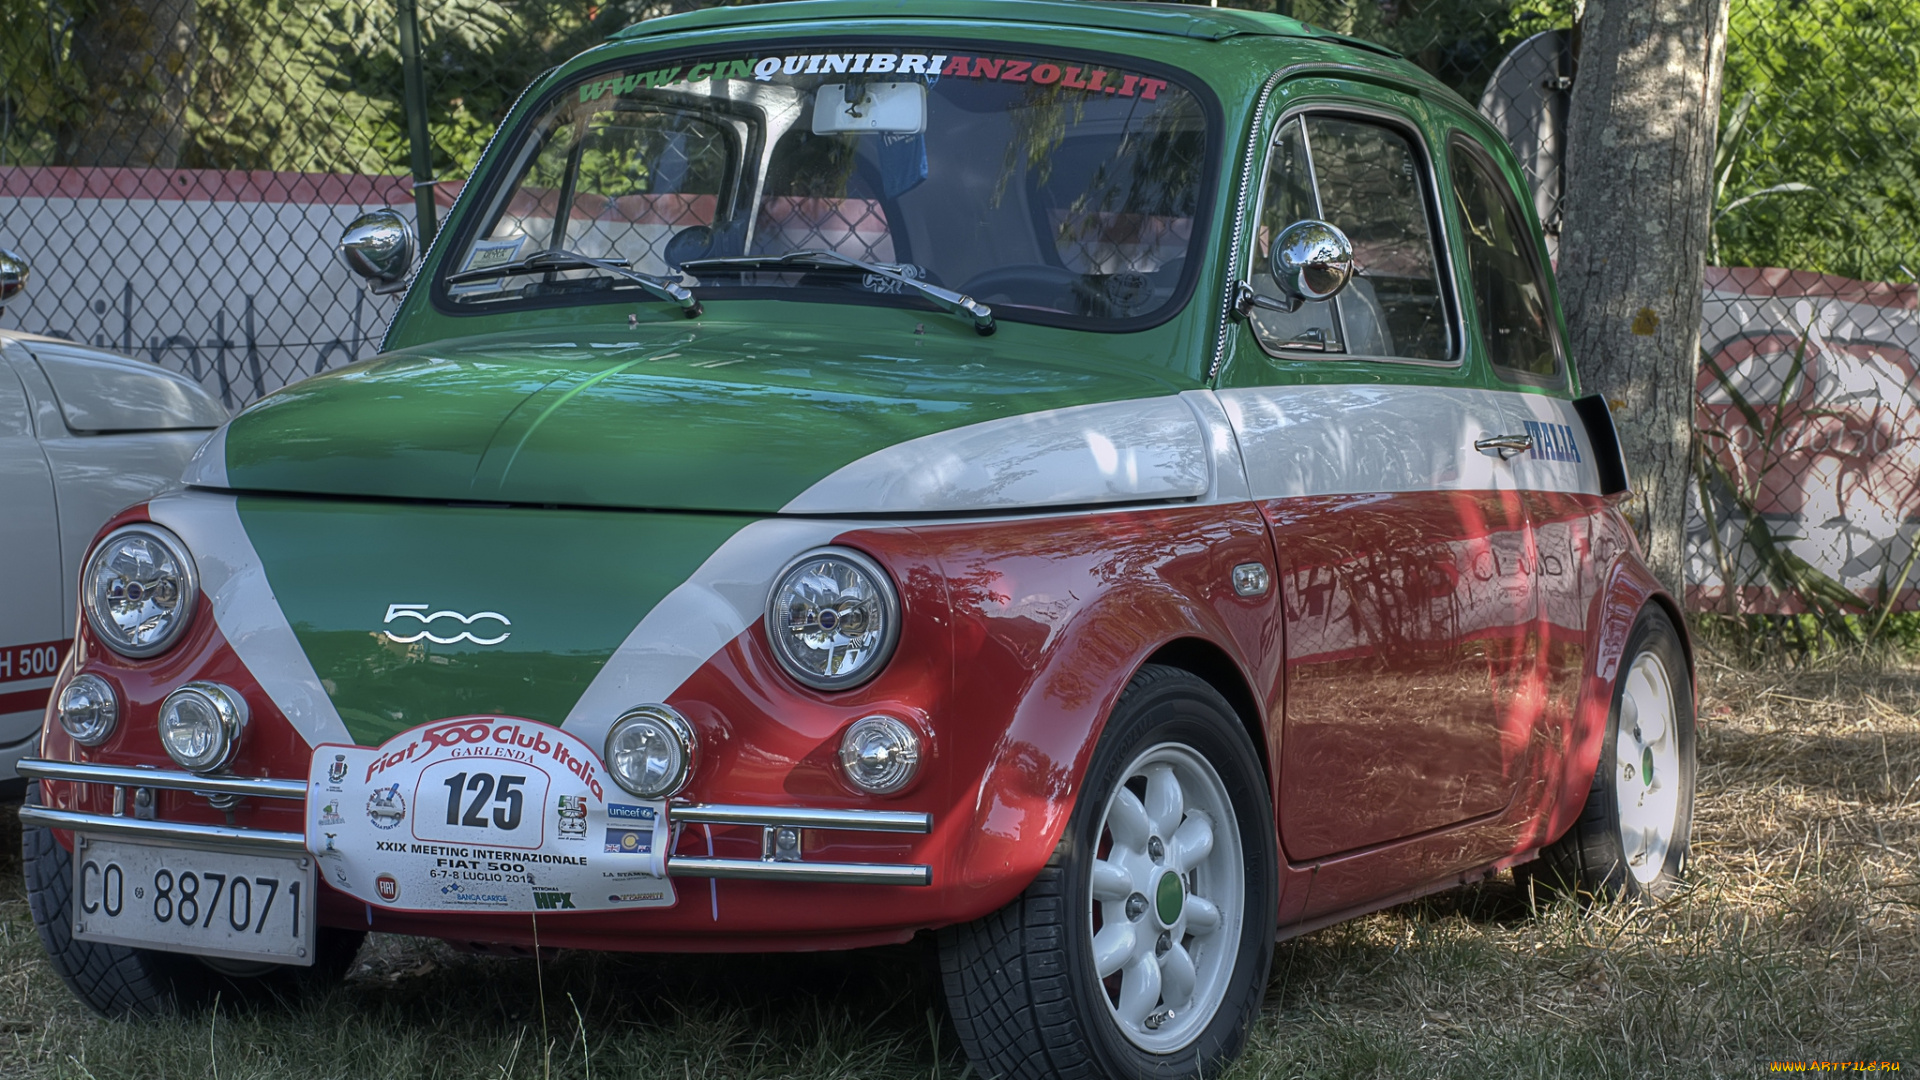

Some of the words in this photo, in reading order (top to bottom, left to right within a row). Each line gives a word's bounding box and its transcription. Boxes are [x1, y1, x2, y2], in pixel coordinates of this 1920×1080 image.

[1522, 420, 1582, 464] ITALIA
[383, 604, 511, 645] 500
[18, 645, 57, 675] 500
[365, 743, 418, 784] Fiat
[411, 718, 494, 763] 500
[492, 724, 551, 755] Club
[552, 743, 604, 804] Italia
[451, 746, 535, 764] GARLENDA
[443, 772, 527, 831] 125
[609, 807, 641, 818] unicef
[376, 841, 407, 854] XXIX
[410, 844, 469, 858] MEETING
[472, 849, 588, 867] INTERNAZIONALE
[429, 869, 460, 880] 6-7-8
[463, 872, 502, 883] LUGLIO
[436, 858, 481, 870] FIAT
[488, 862, 524, 873] 500
[379, 880, 395, 895] FIAT
[456, 893, 481, 901] BANCA
[481, 894, 508, 902] CARIGE
[80, 860, 124, 917] CO
[153, 868, 301, 938] 887071
[533, 892, 576, 909] HPX
